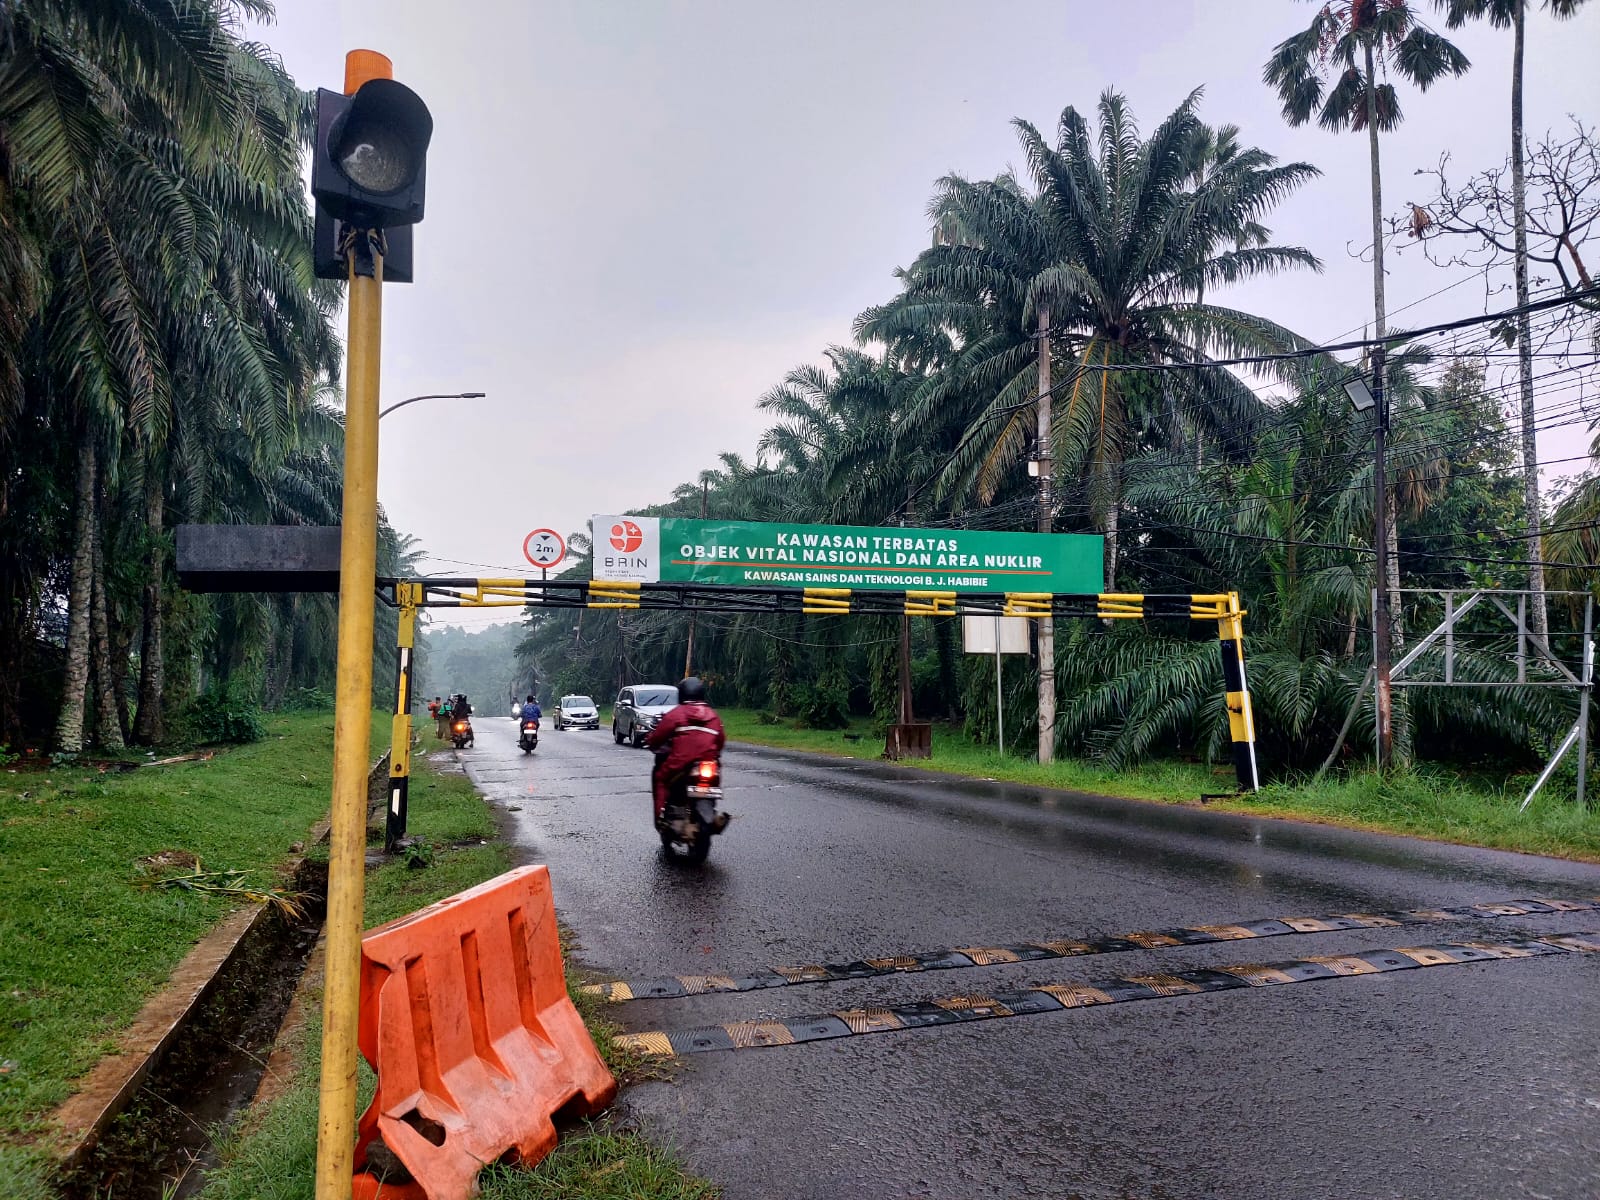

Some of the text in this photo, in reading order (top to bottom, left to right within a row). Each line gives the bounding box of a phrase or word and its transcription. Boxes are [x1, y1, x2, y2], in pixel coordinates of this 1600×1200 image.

[535, 543, 554, 553] 2m
[777, 533, 958, 551] KAWASAN TERBATAS
[604, 557, 648, 568] BRIN
[680, 544, 1043, 568] OBJEK VITAL NASIONAL DAN AREA NUKLIR
[744, 570, 988, 586] KAWASAN SAINS DAN TEKNOLOGI B. J. HABIBIE
